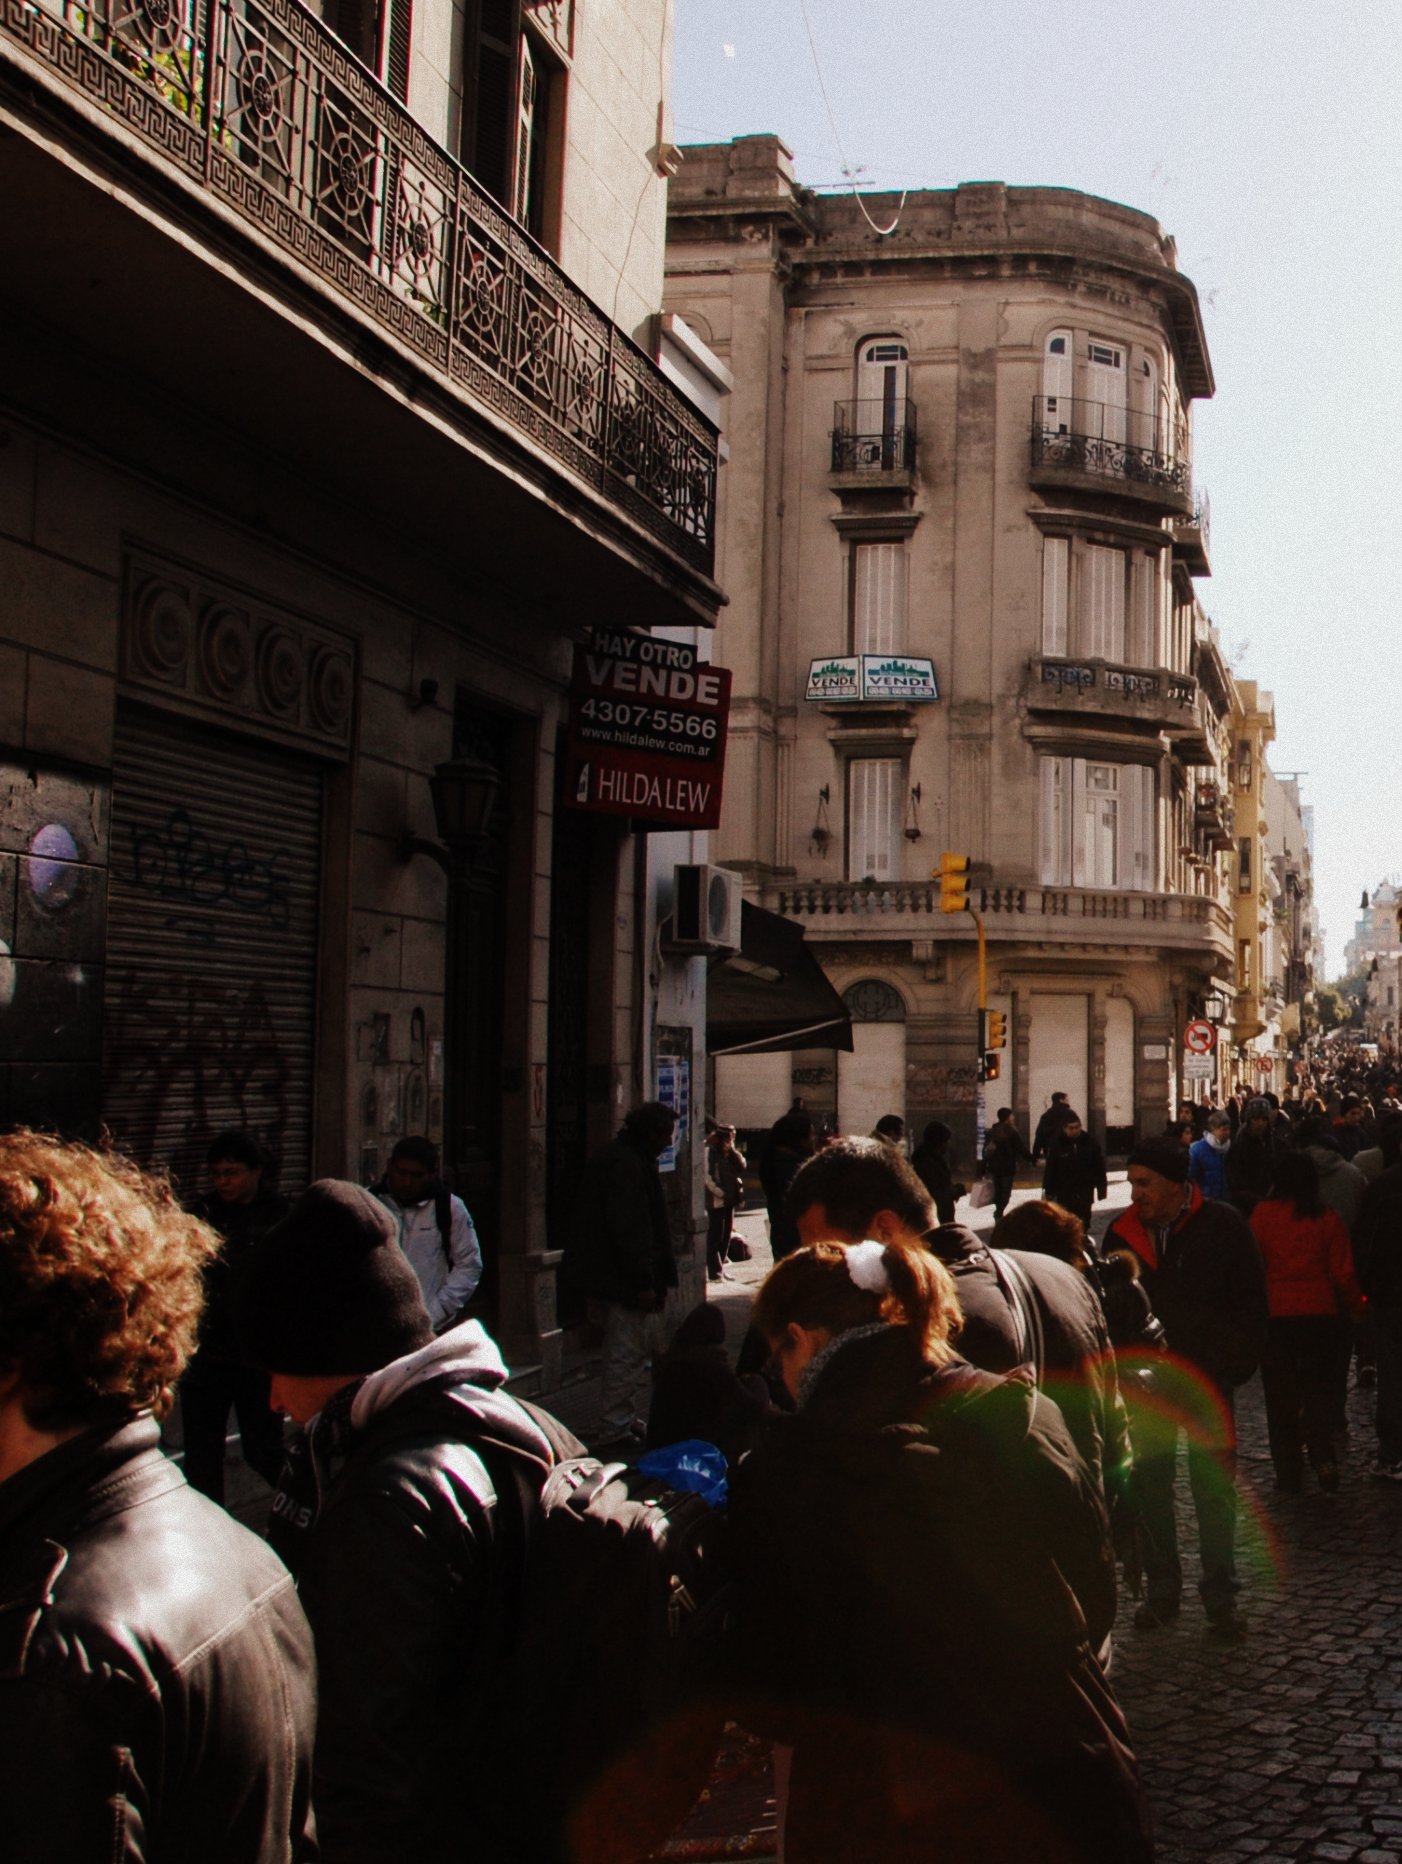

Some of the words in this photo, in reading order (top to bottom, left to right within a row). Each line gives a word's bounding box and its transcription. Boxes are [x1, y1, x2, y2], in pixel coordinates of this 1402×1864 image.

[595, 633, 636, 658] HAY
[639, 641, 694, 669] OTRO
[586, 654, 720, 706] VENDE
[811, 677, 856, 687] VENDE
[870, 677, 931, 687] VENDE
[580, 698, 718, 739] 4307-5566
[581, 726, 711, 757] www.hildalew.com.ar
